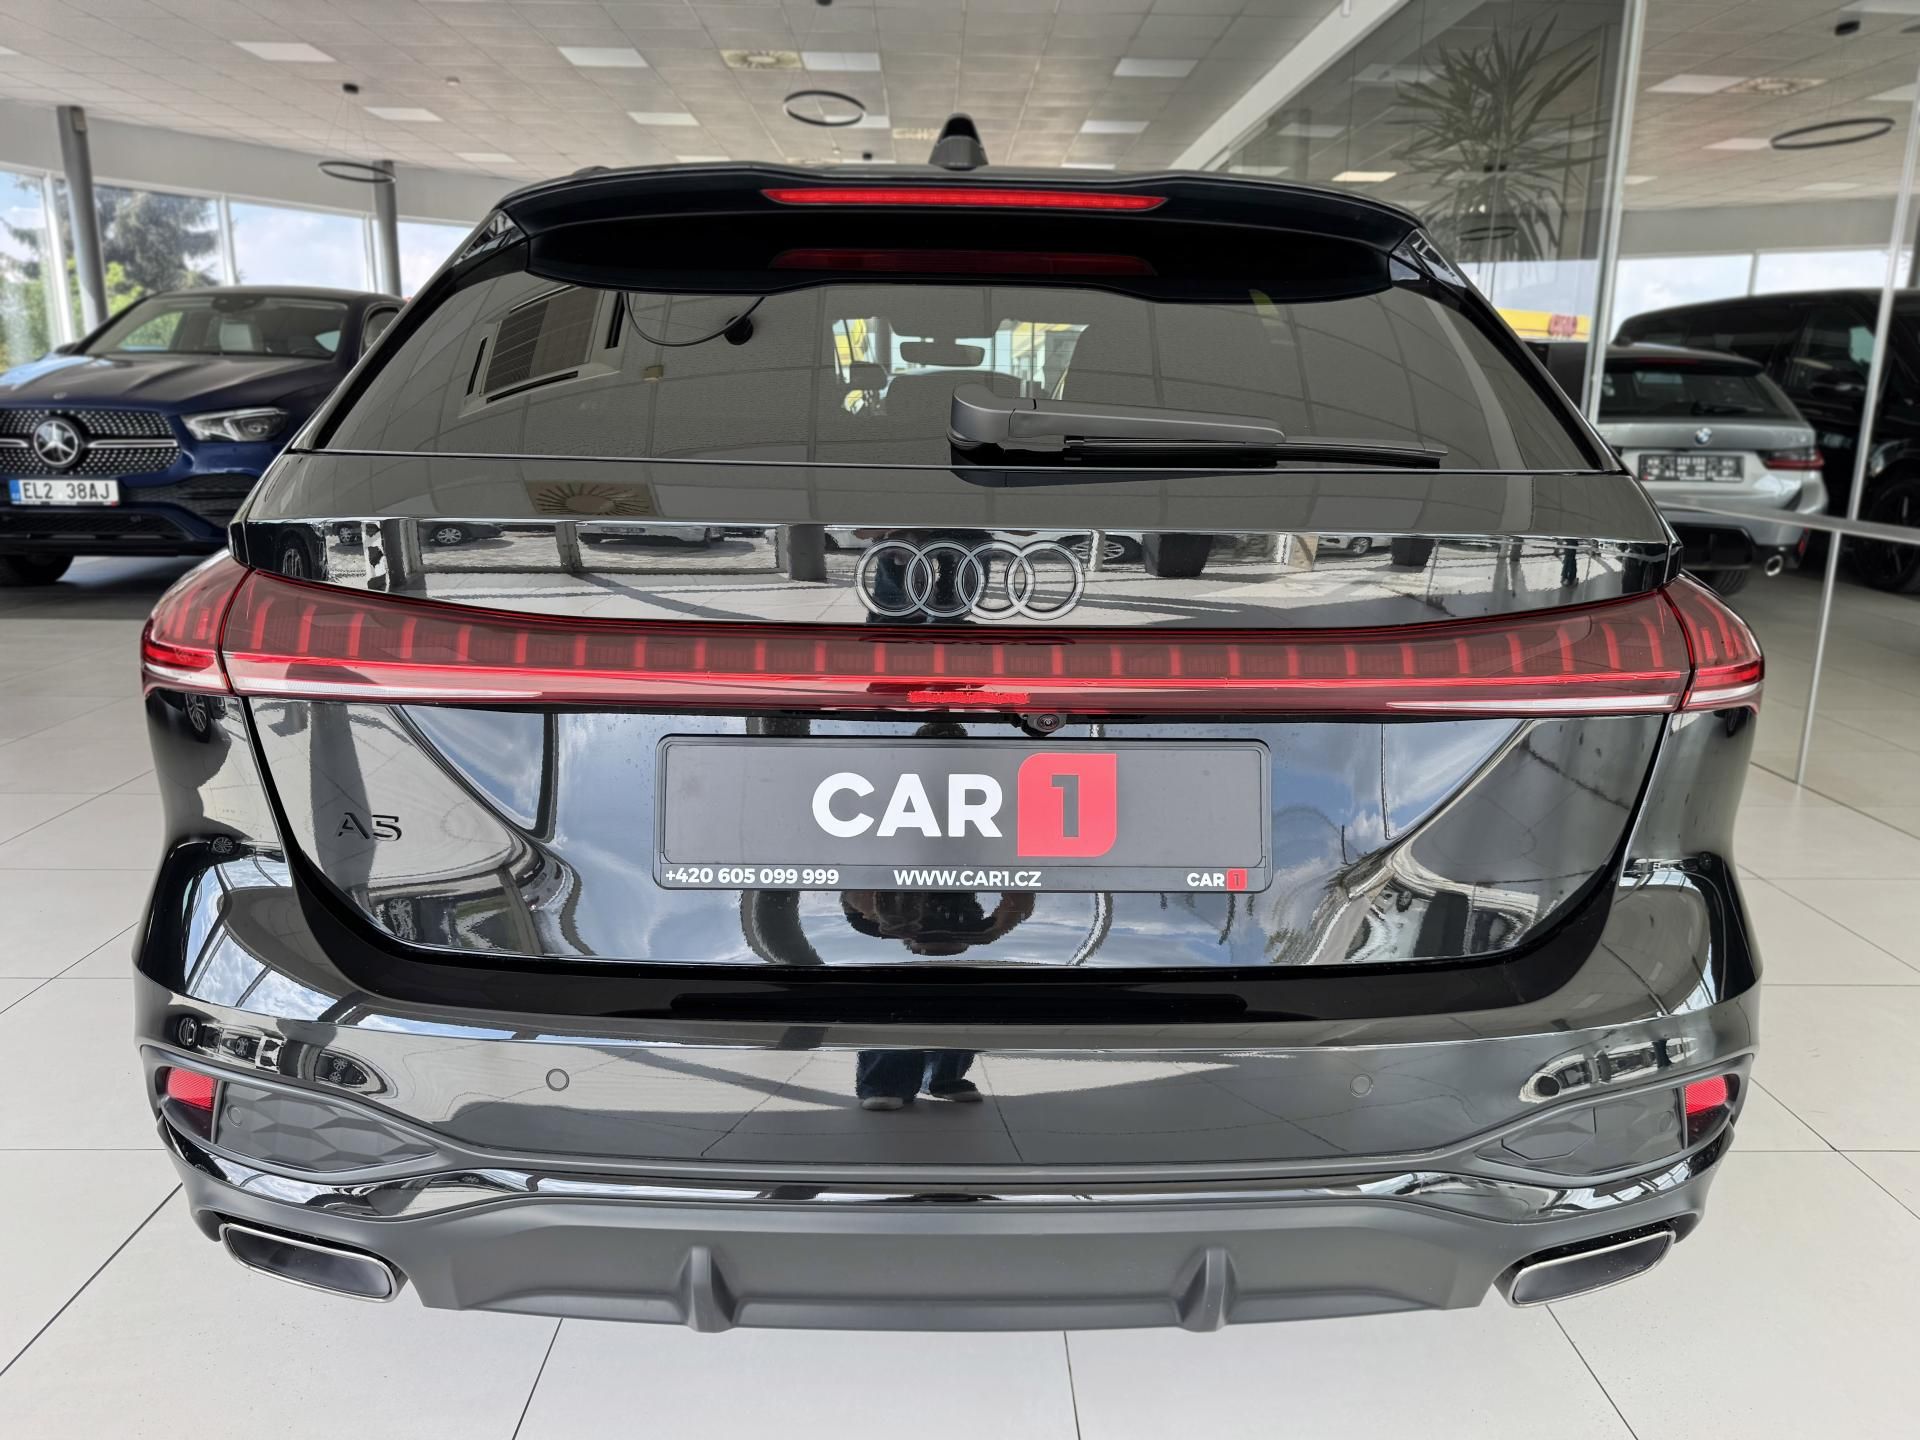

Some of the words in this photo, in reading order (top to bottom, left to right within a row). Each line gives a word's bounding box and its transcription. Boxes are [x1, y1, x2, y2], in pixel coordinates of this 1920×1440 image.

[22, 482, 54, 499] EL2
[66, 482, 110, 499] 38AJ
[812, 772, 1003, 838] CAR
[337, 812, 402, 841] A5
[665, 867, 714, 883] +420
[717, 867, 756, 883] 605
[759, 868, 799, 884] 099
[802, 868, 840, 885] 999
[893, 869, 1042, 887] WWW.CAR1.CZ
[1186, 872, 1225, 887] CAR
